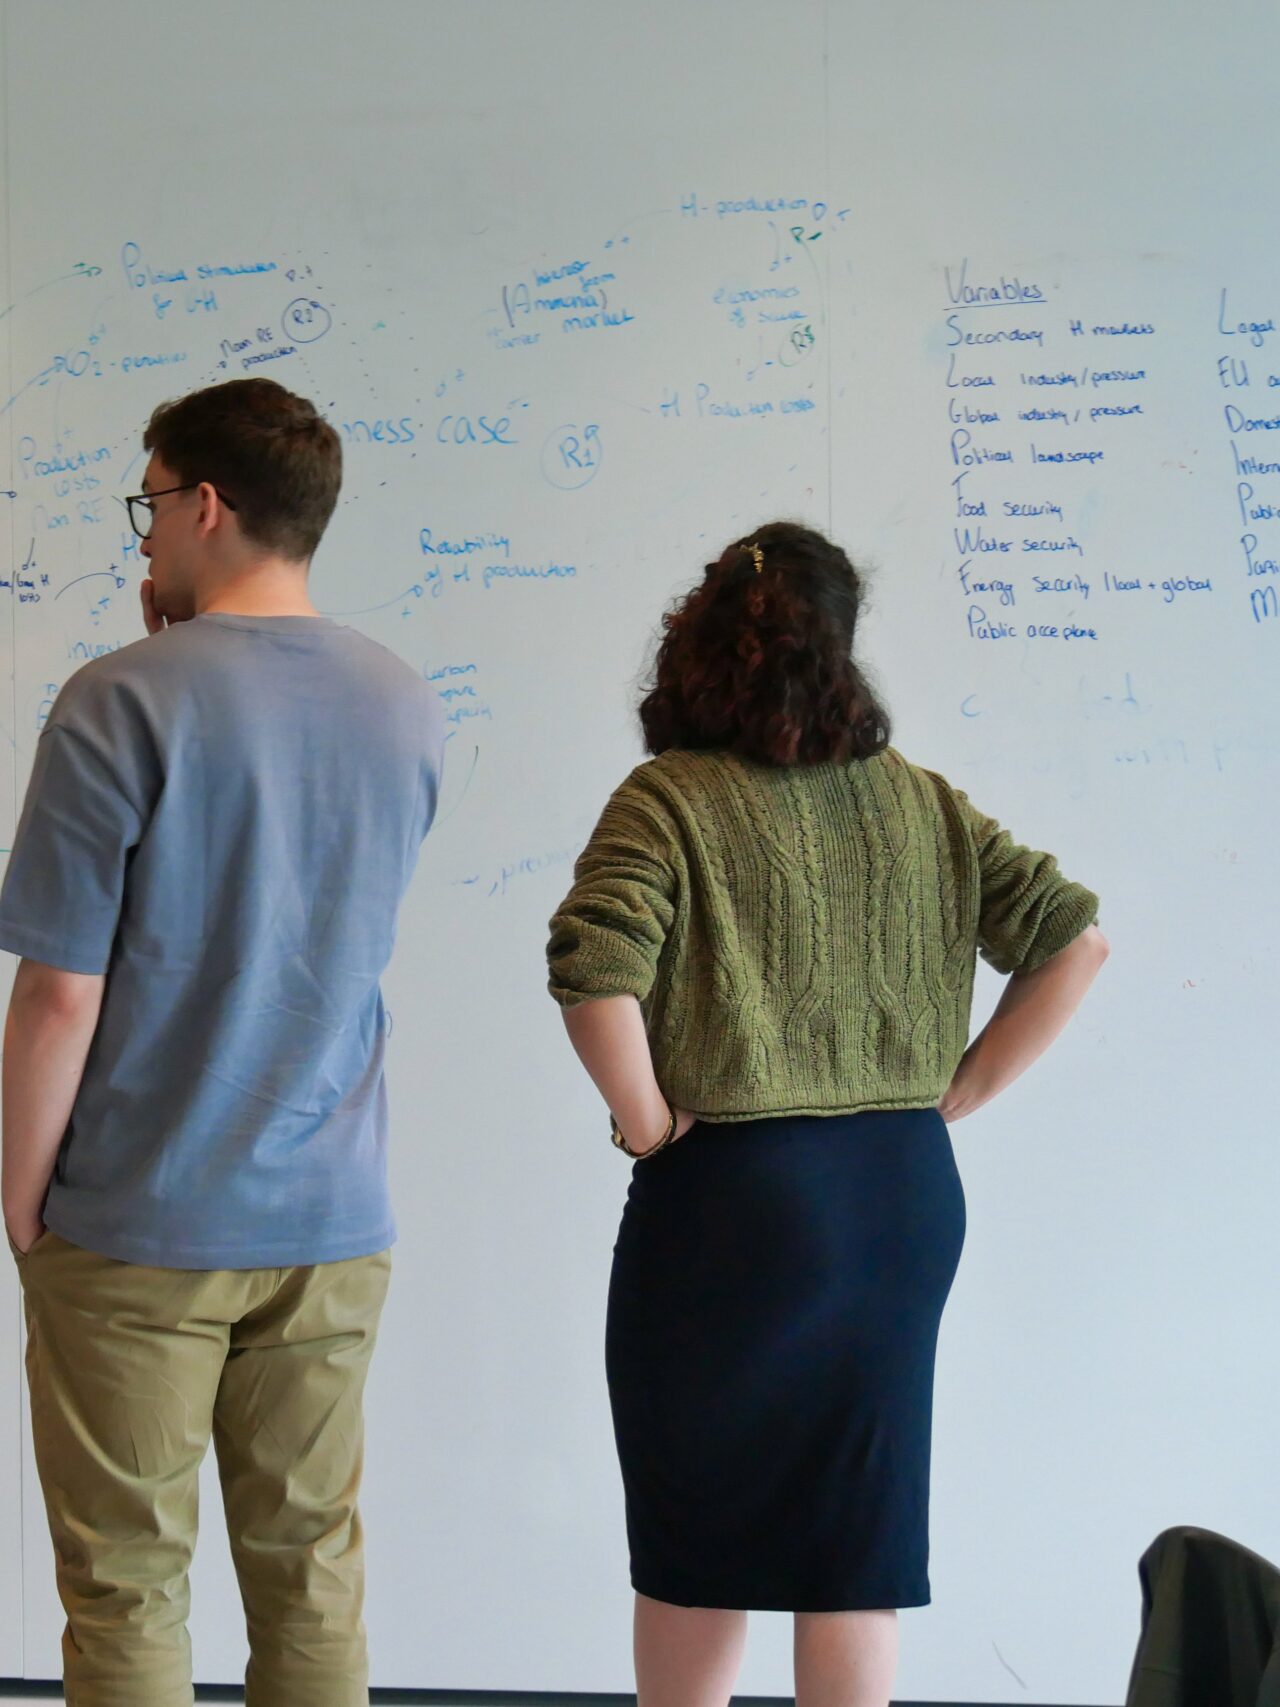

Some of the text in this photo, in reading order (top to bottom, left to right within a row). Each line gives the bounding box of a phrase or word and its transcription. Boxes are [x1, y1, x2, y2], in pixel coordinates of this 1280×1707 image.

[944, 257, 1042, 304] Variables
[946, 315, 1044, 347] Secondary
[1217, 355, 1250, 388] EU
[343, 410, 520, 445] ness case
[1002, 501, 1064, 522] security
[954, 525, 1084, 557] Water security
[1031, 575, 1091, 600] security
[967, 604, 1018, 638] Public
